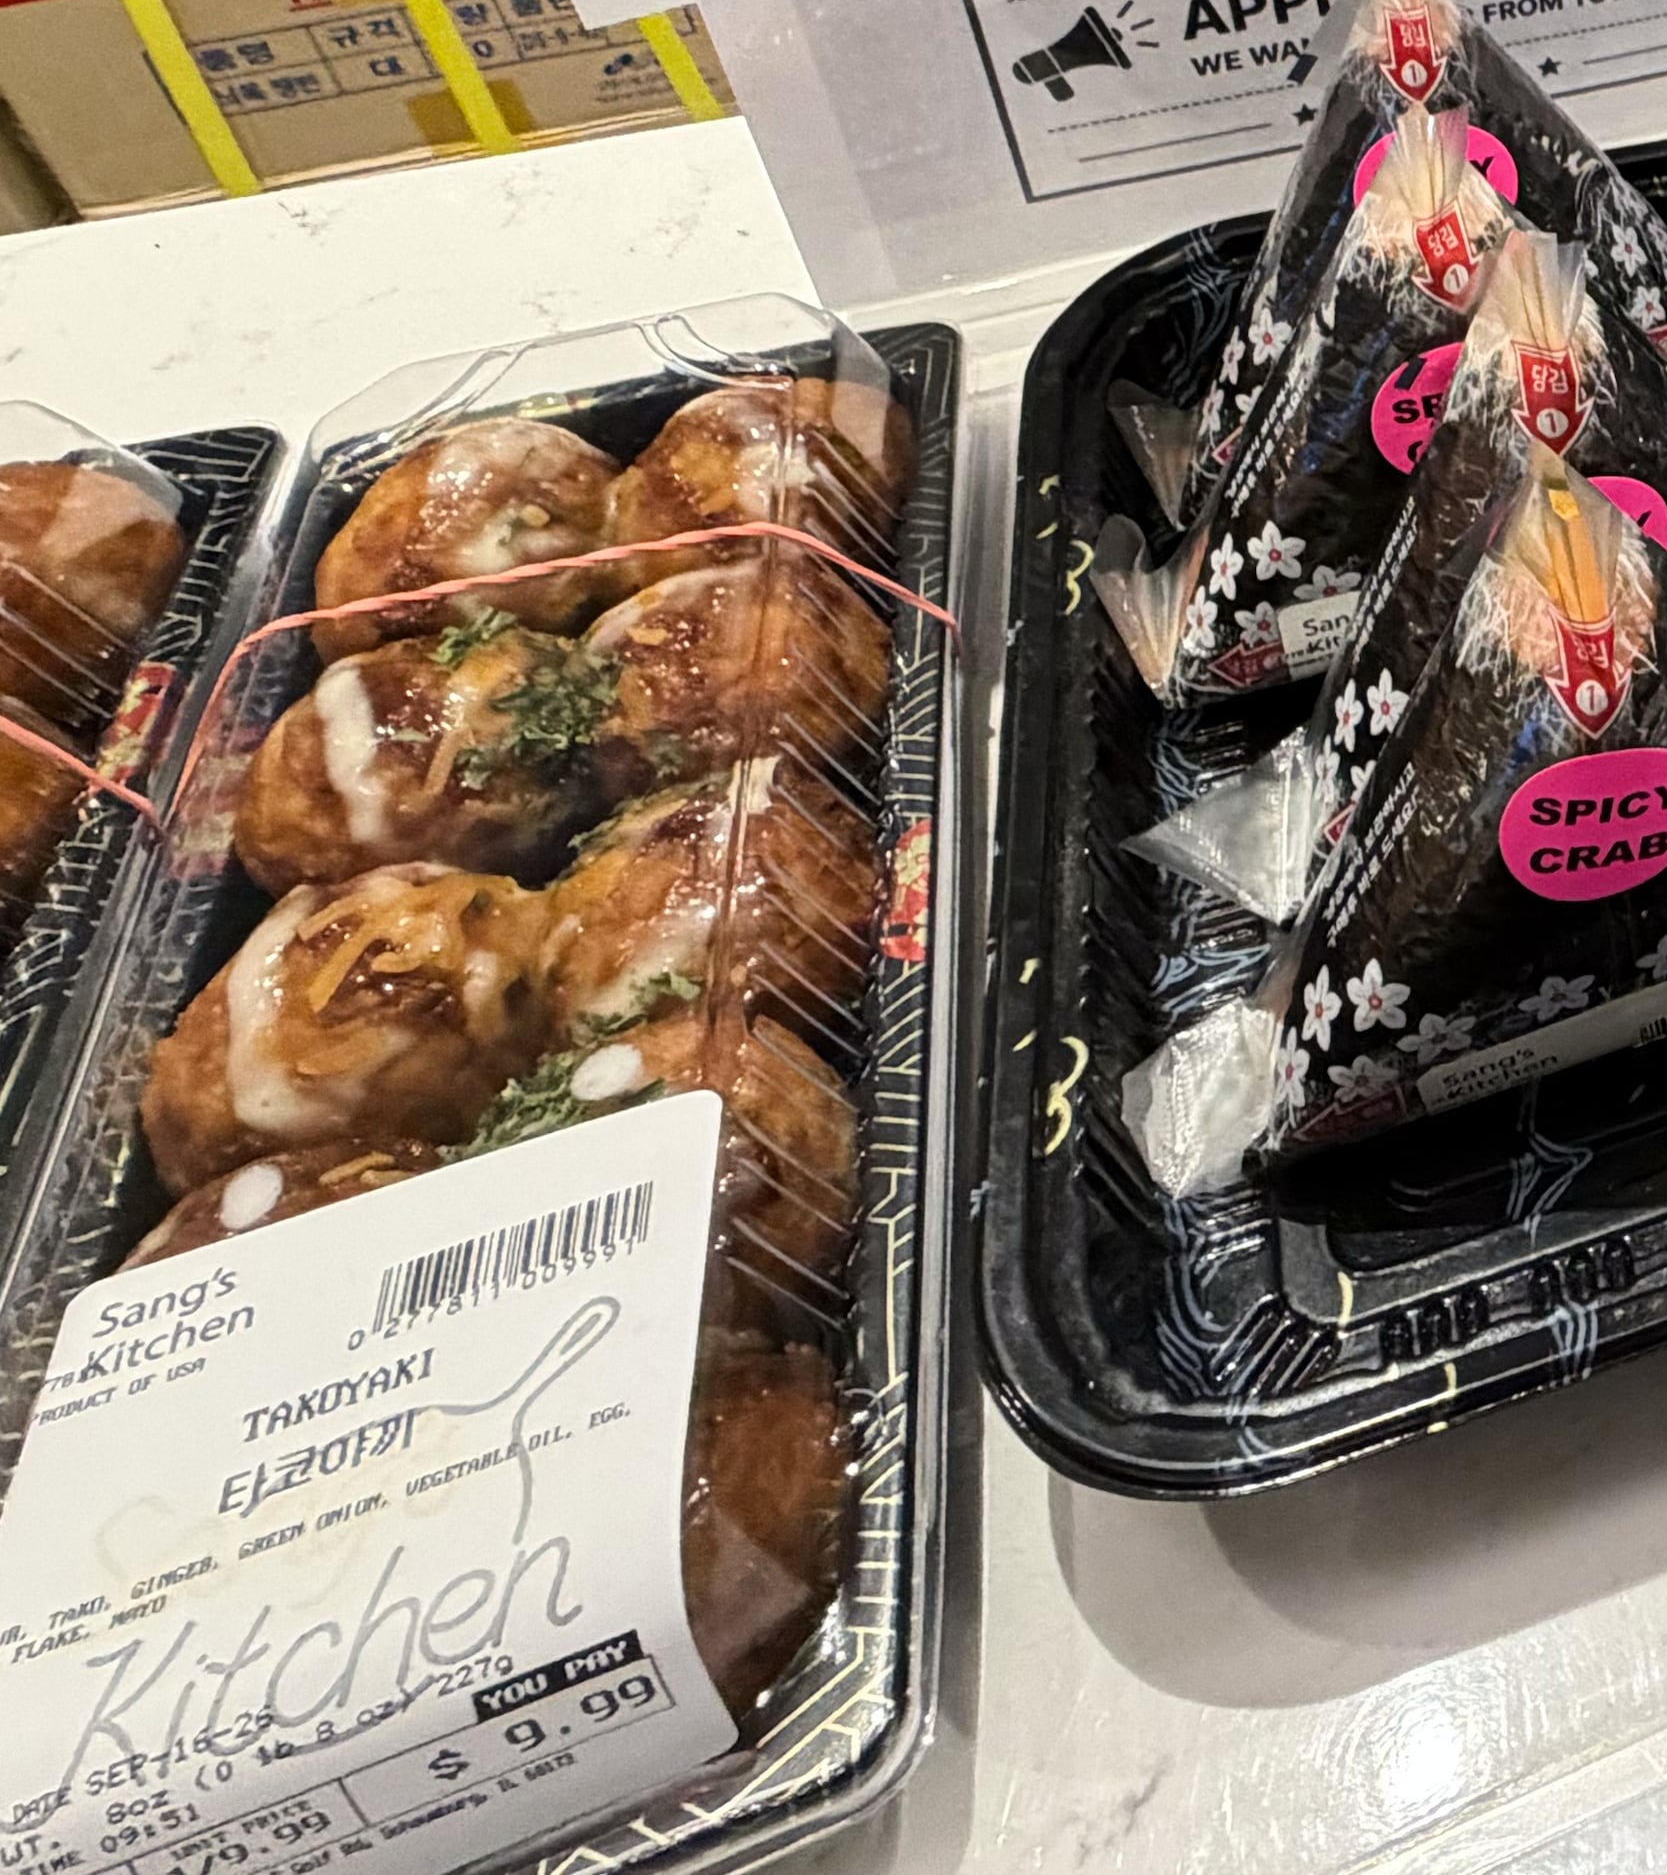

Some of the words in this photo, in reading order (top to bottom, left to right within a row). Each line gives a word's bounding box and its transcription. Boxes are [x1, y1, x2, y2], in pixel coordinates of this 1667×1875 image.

[1190, 52, 1244, 78] WE
[1442, 1048, 1535, 1088] Sang's
[1447, 1054, 1558, 1101] Kitchen
[92, 1266, 238, 1339] Sang's
[78, 1305, 256, 1384] Kitchen
[128, 1373, 157, 1396] OF
[166, 1357, 207, 1383] USA
[243, 1347, 436, 1443] TAKOYAKI
[237, 1520, 306, 1561] GREEN
[404, 1440, 521, 1498] VEGETABLE
[109, 1594, 167, 1630] MAYO
[479, 1671, 549, 1711] YOU
[562, 1639, 630, 1681] PAY
[427, 1747, 470, 1781] $
[503, 1674, 657, 1753] 9.99
[12, 1787, 72, 1825] DATE
